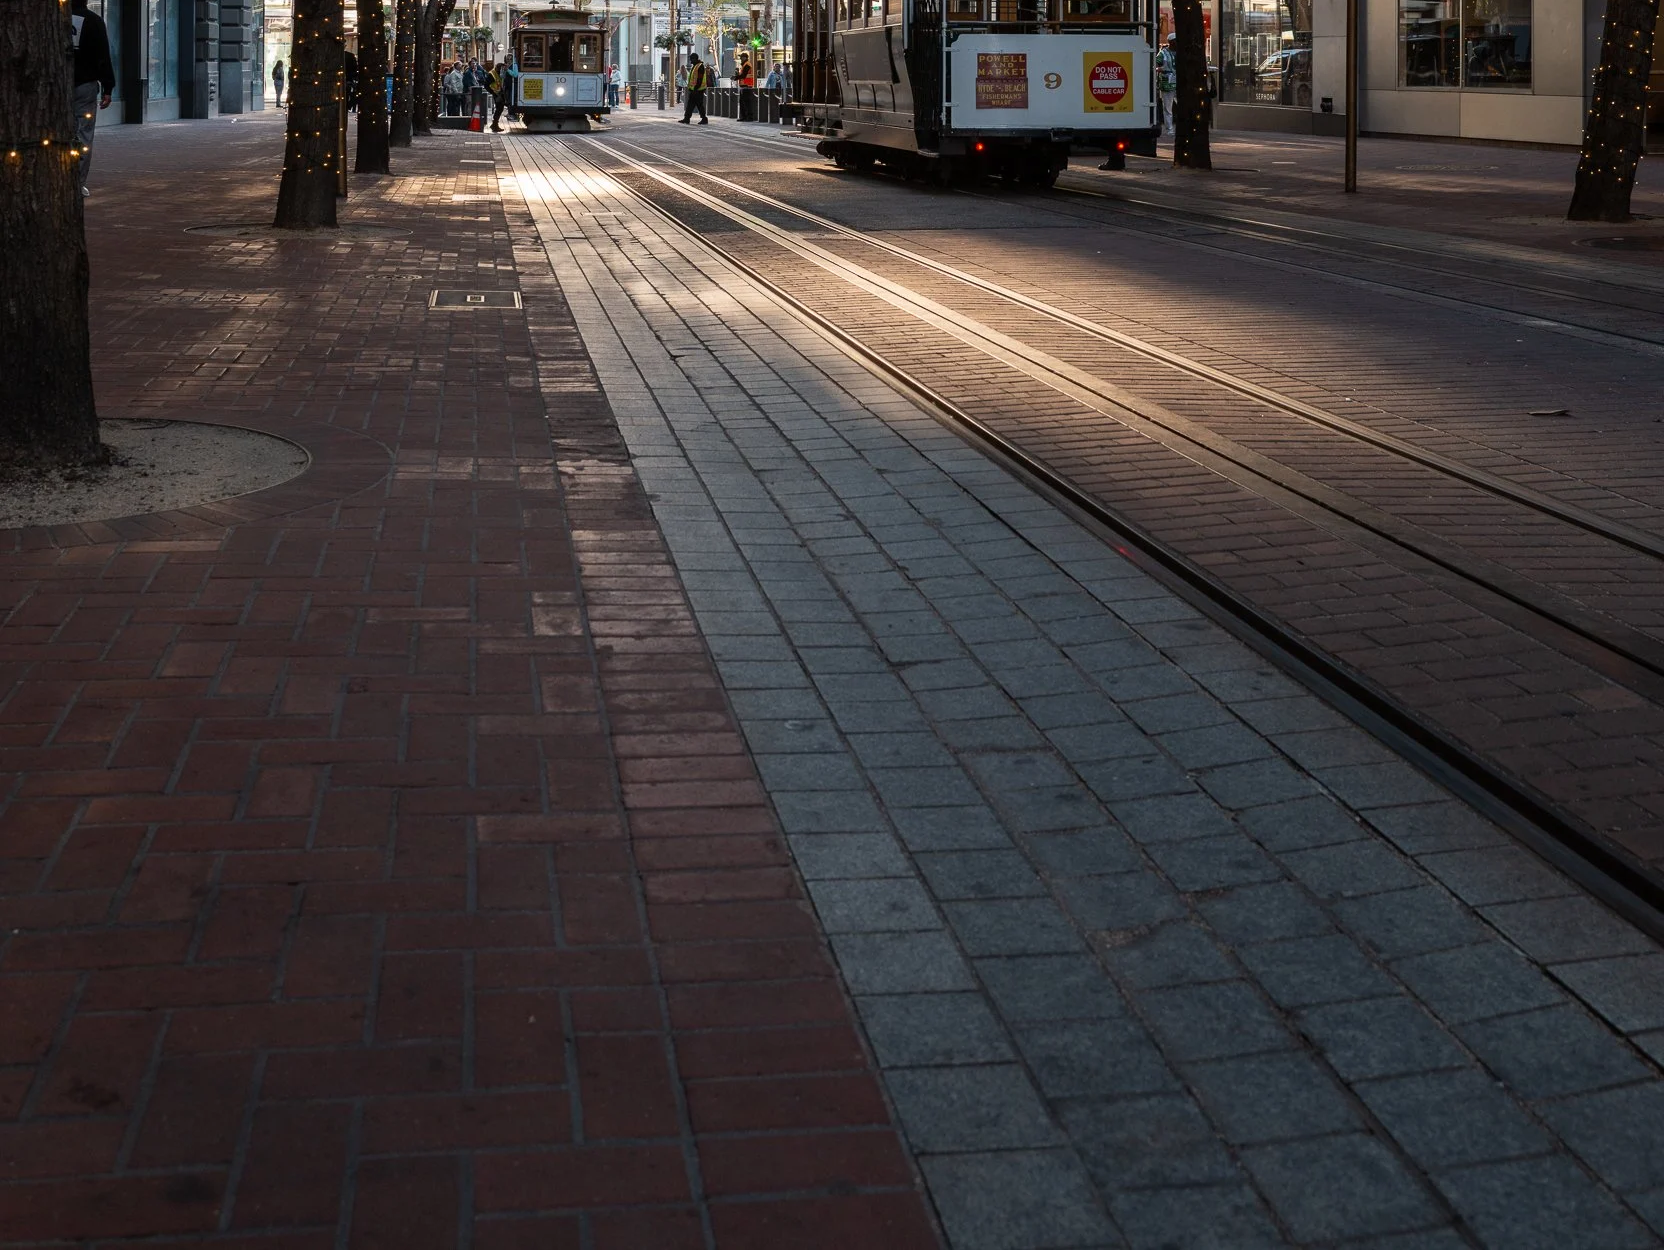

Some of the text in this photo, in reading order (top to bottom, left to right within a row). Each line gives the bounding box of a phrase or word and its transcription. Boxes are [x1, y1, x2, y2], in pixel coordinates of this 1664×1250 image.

[979, 55, 1025, 63] POWELL
[978, 68, 1025, 76] MARKET
[1095, 66, 1122, 74] DO NOT
[1043, 72, 1062, 90] 9
[977, 84, 996, 93] HYDE
[1004, 83, 1026, 92] BEACH
